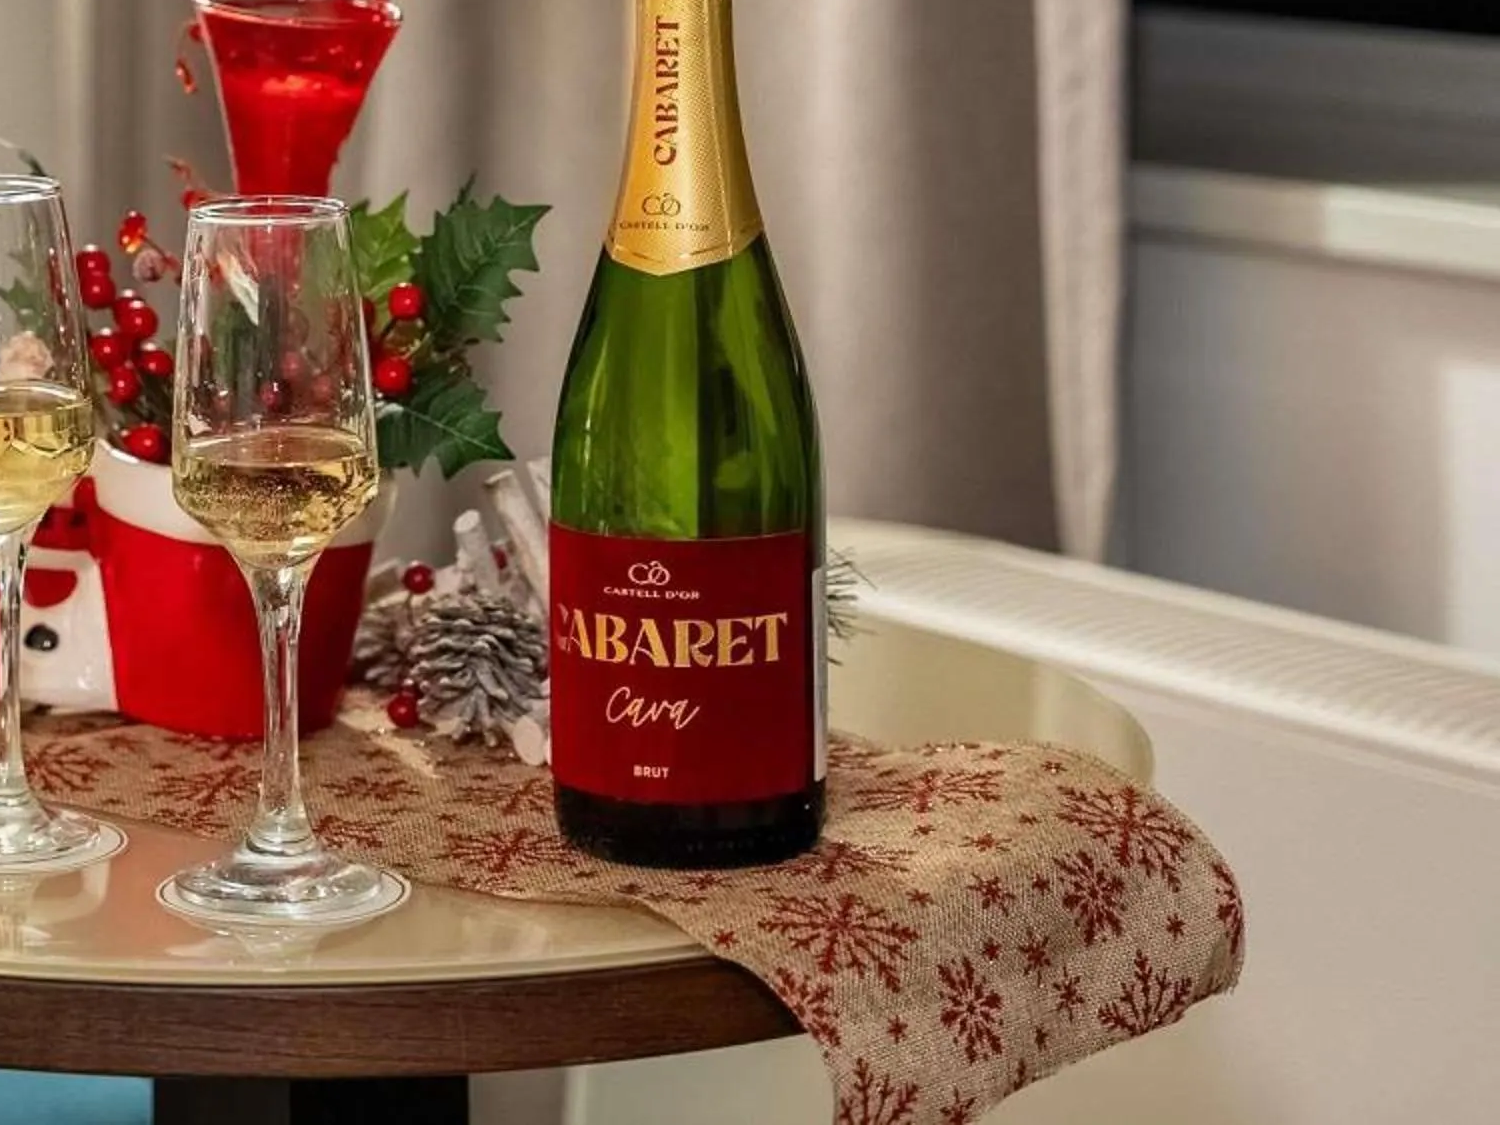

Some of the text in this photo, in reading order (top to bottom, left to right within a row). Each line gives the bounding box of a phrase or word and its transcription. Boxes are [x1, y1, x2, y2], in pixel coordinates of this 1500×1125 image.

[653, 16, 680, 166] CABARET
[603, 586, 661, 598] CASTELL
[605, 686, 700, 730] Cava
[633, 765, 669, 778] BRUT
